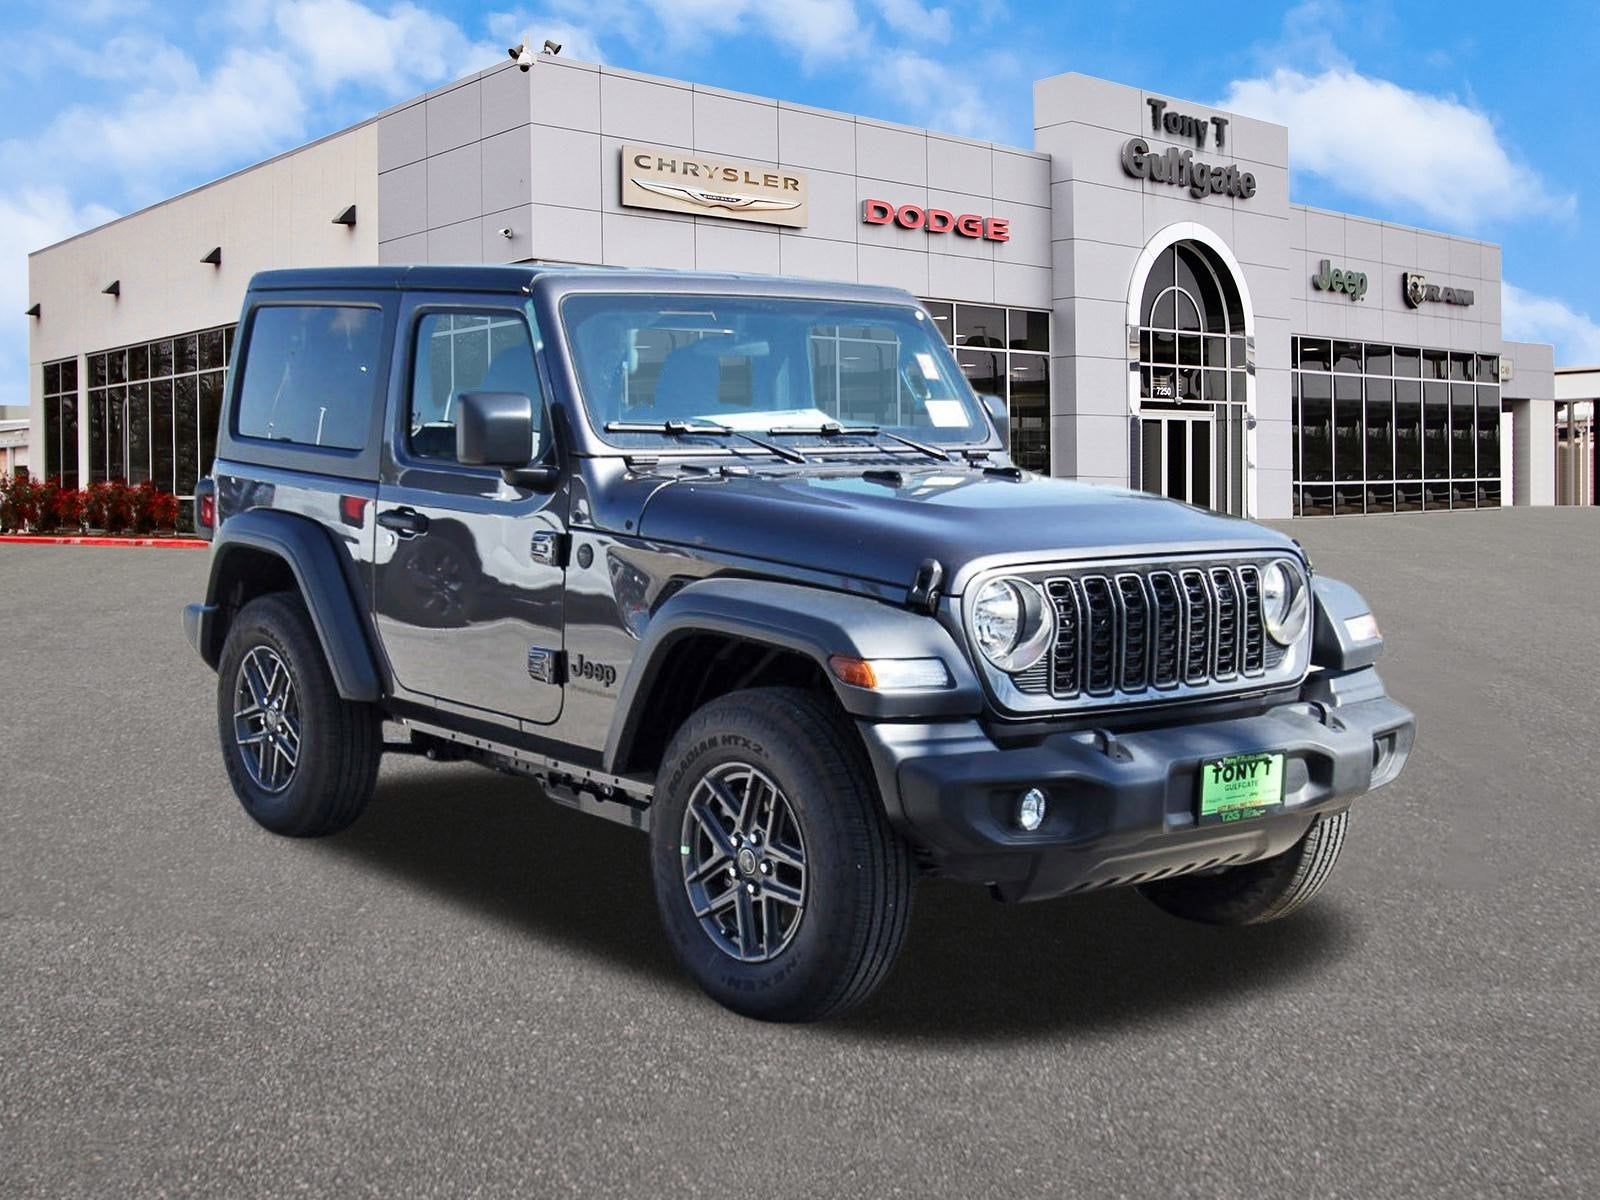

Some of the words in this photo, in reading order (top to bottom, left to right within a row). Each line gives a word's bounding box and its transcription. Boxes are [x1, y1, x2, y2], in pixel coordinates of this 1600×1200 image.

[1147, 98, 1208, 148] Tony
[1211, 117, 1229, 148] T
[633, 154, 800, 192] CHRYSLER
[1121, 138, 1257, 199] Gulfgate
[863, 198, 1011, 243] DODGE
[1312, 259, 1368, 301] Jeep
[1424, 284, 1475, 306] RAM
[1156, 386, 1172, 396] 7250
[571, 654, 616, 688] Jeep
[1212, 761, 1259, 785] TONY
[1263, 757, 1273, 776] T
